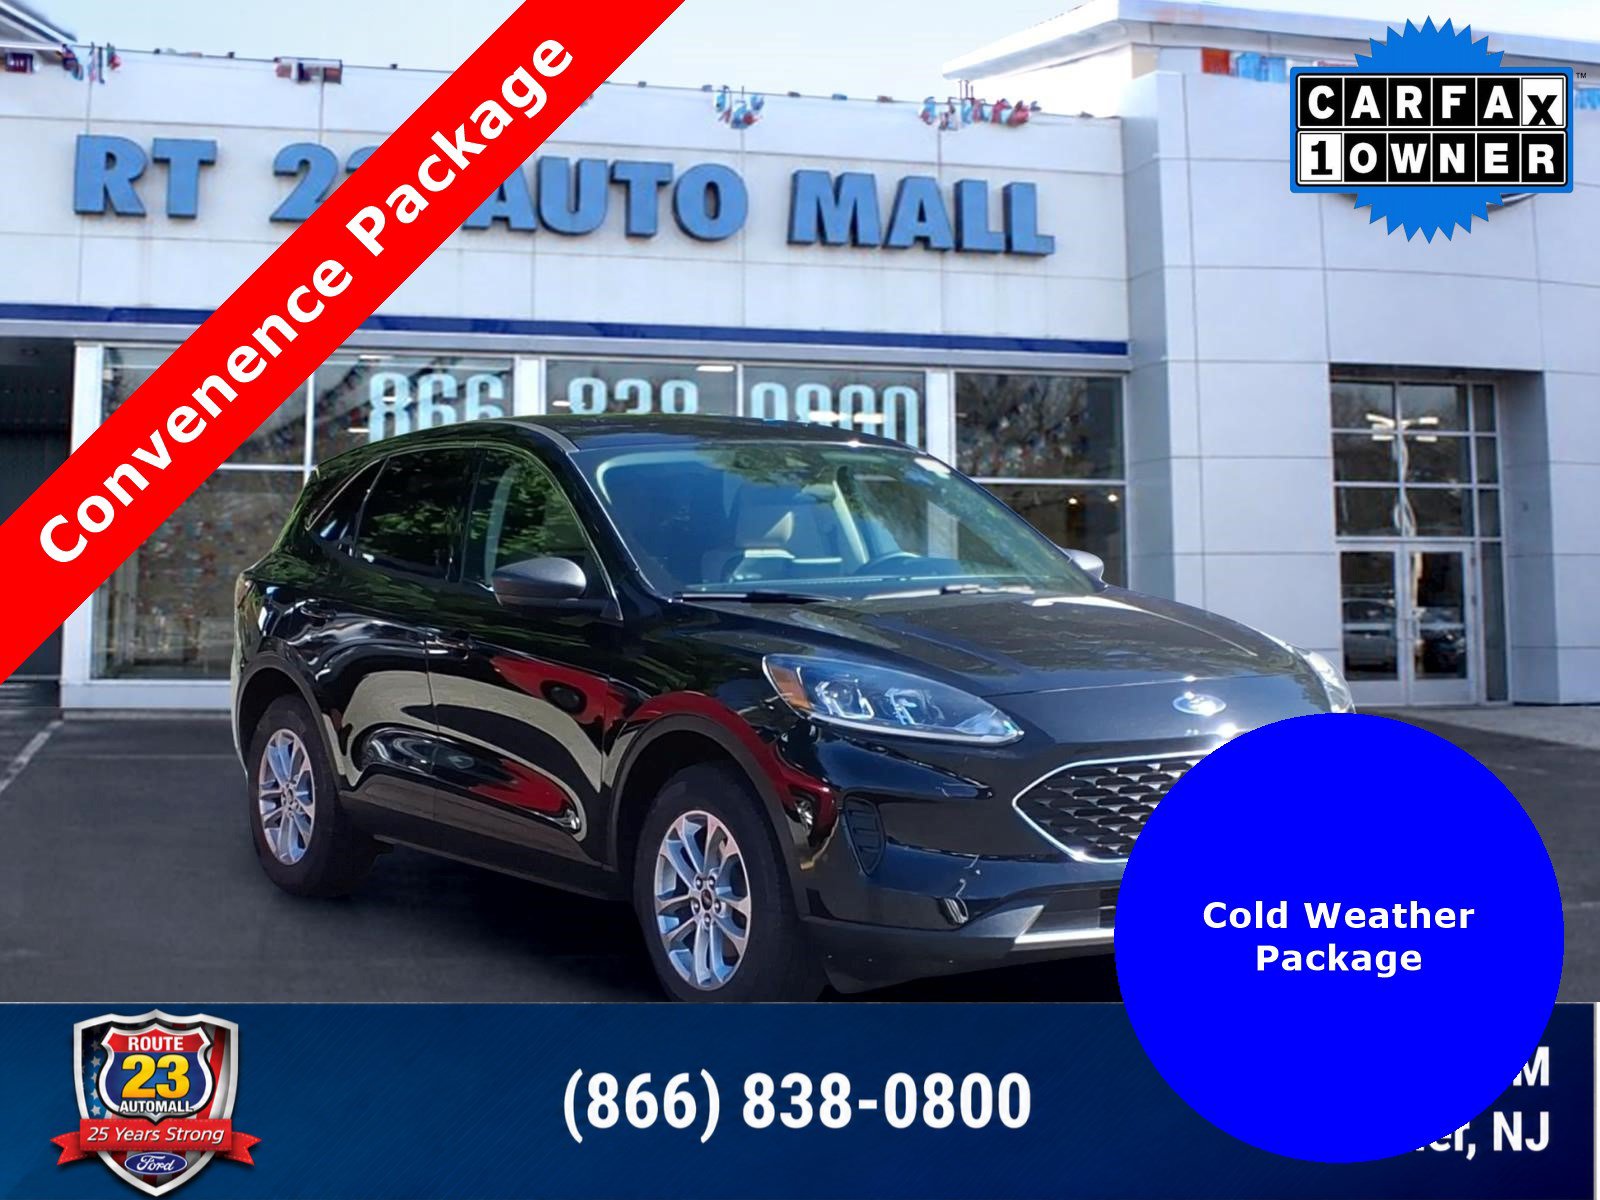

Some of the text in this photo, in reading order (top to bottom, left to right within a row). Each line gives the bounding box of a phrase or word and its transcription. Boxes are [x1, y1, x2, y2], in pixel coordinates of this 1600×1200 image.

[74, 135, 1055, 257] RT 2 AUTO MALL
